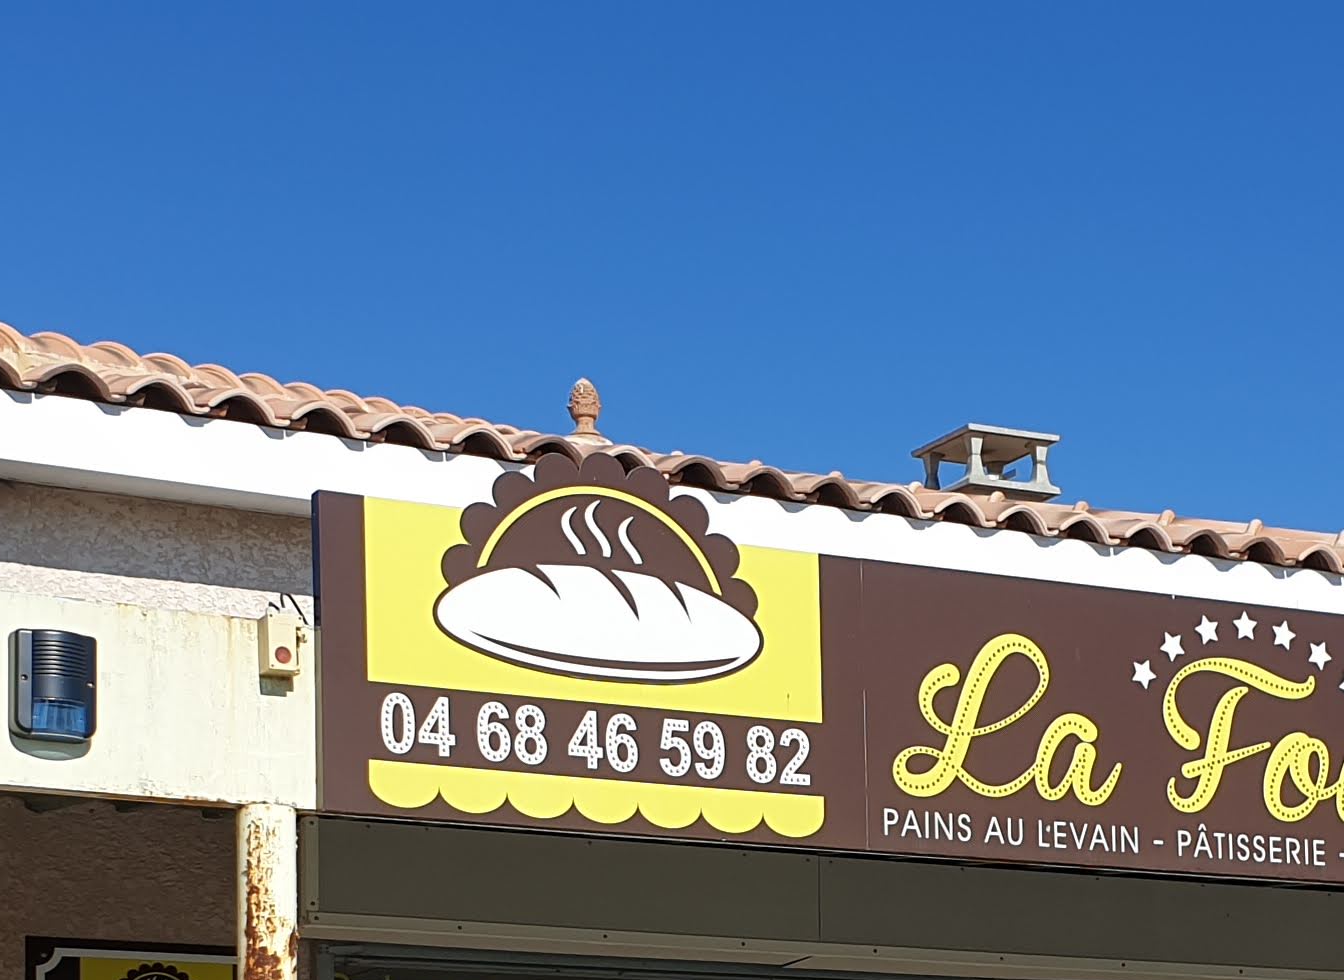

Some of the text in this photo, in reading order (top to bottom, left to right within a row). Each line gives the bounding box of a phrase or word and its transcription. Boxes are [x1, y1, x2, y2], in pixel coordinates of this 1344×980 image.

[380, 692, 812, 787] 04 68 46 59 82
[892, 632, 1122, 806] La
[882, 807, 972, 842] PAINS
[984, 815, 1024, 846] AU
[1177, 823, 1326, 866] PÂTISSERIE
